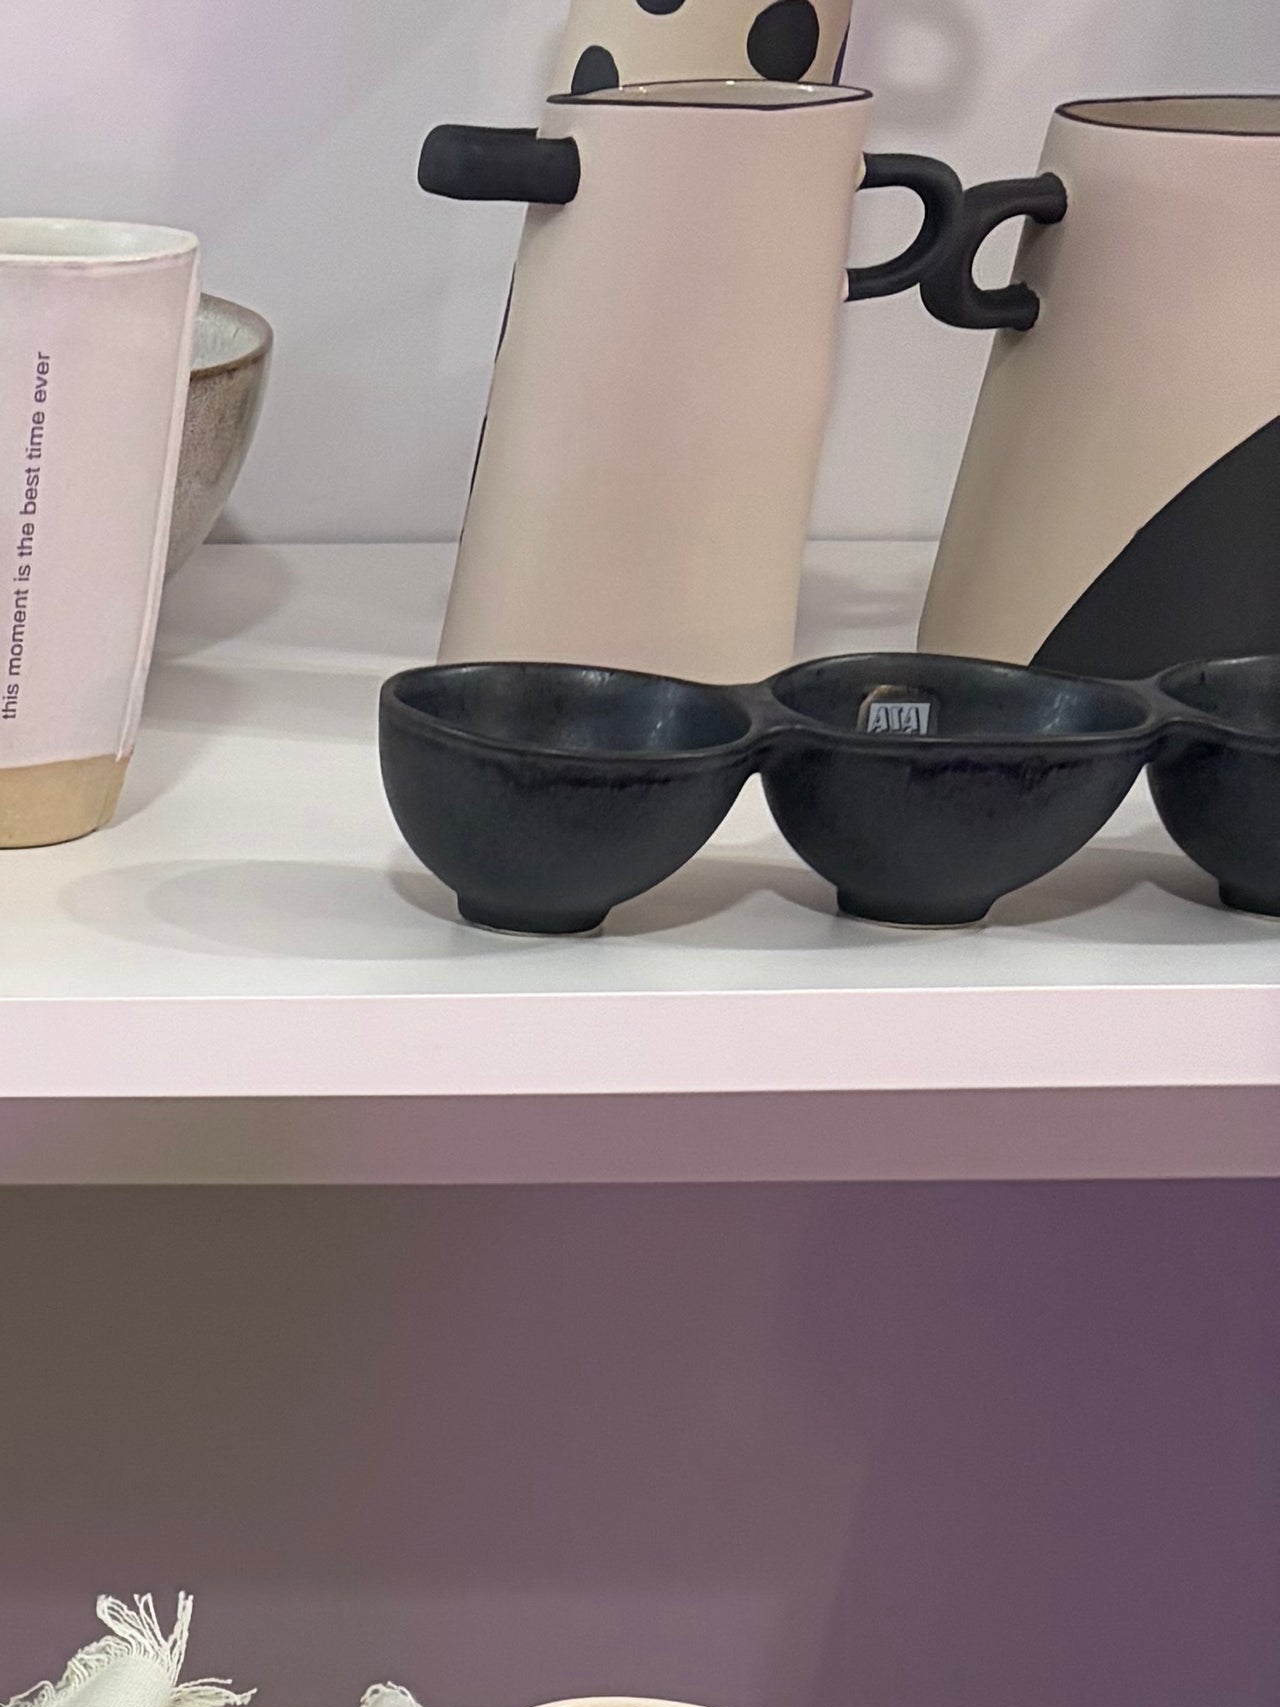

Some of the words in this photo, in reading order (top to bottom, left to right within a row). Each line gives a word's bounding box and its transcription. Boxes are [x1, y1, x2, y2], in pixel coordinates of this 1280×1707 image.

[34, 351, 51, 403] ever
[25, 411, 45, 460] time
[19, 467, 41, 515] best
[17, 522, 35, 557] the
[13, 564, 31, 582] is
[8, 589, 29, 676] moment
[1, 683, 20, 720] this
